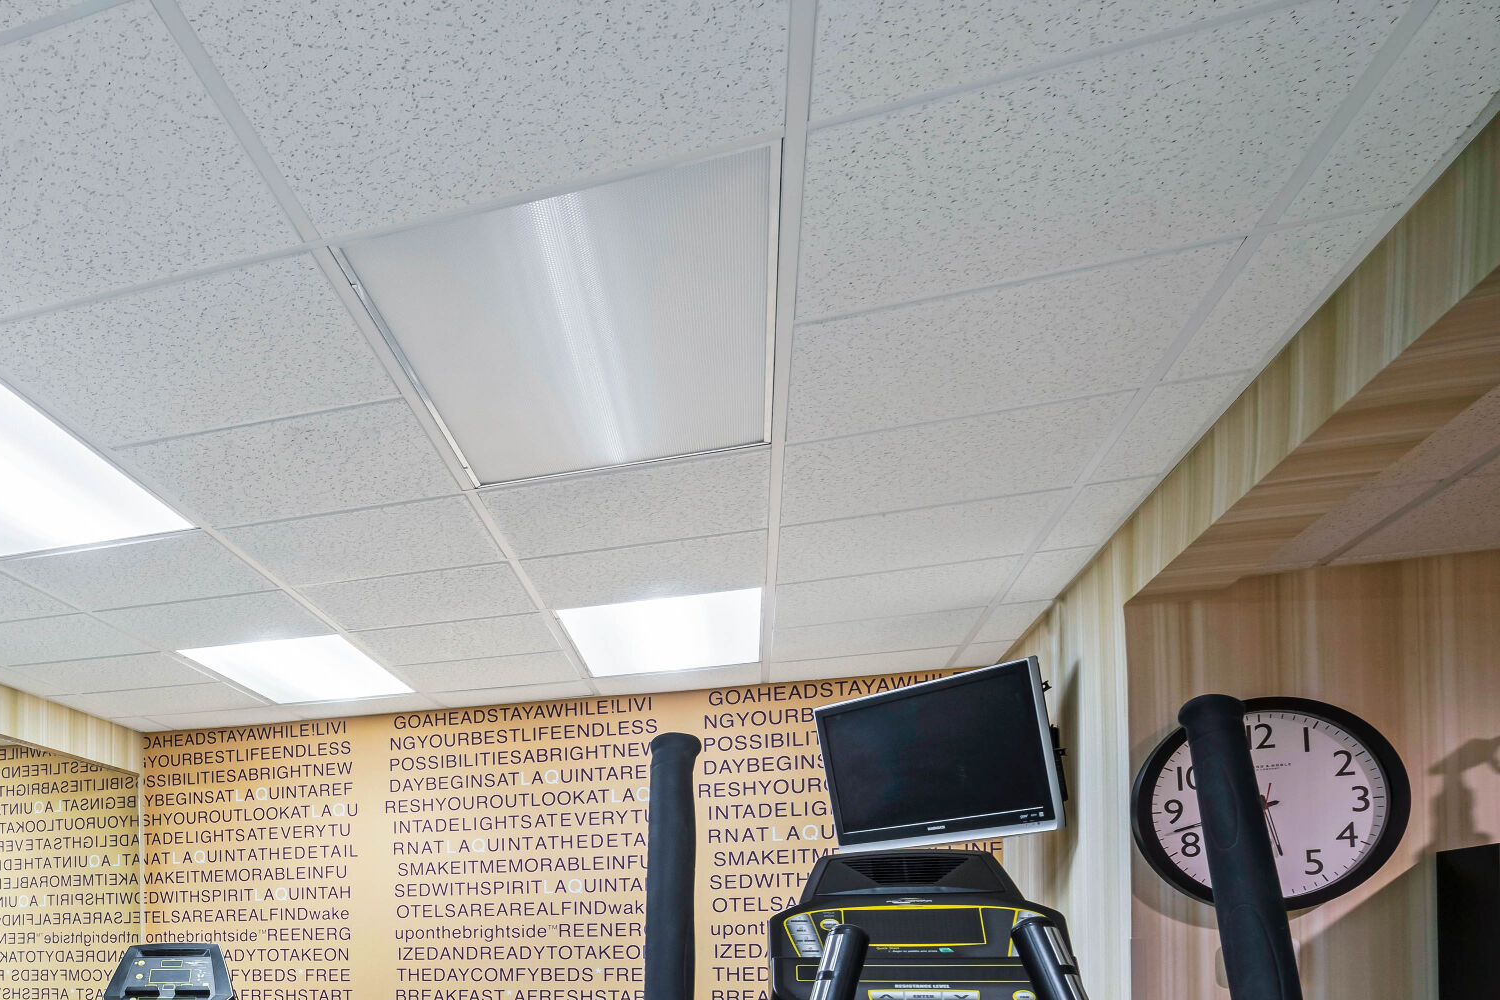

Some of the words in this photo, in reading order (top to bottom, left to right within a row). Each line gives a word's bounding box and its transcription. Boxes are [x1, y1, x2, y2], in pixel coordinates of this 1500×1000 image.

[394, 697, 652, 730] GOAHEADSTAYAWHILE!LIVI
[390, 718, 658, 751] NGYOURBESTLIFEENDLESS
[1303, 726, 1311, 752] 1
[143, 741, 351, 768] YOURBESTLIFEENDLESS
[1333, 750, 1356, 777] 2
[144, 761, 353, 787] SSIBILITIESABRIGHTNEW
[708, 801, 833, 820] INTADELIG
[1351, 785, 1370, 812] 3
[1164, 799, 1184, 825] 9
[1181, 832, 1201, 858] 8
[1335, 821, 1359, 848] 4
[1304, 849, 1324, 876] 5
[394, 877, 647, 897] SEDWITHSPIRITLAQUINTA
[710, 920, 769, 939] upont
[398, 945, 645, 961] IZEDANDREADYTOTAKEO
[714, 943, 768, 959] IZED
